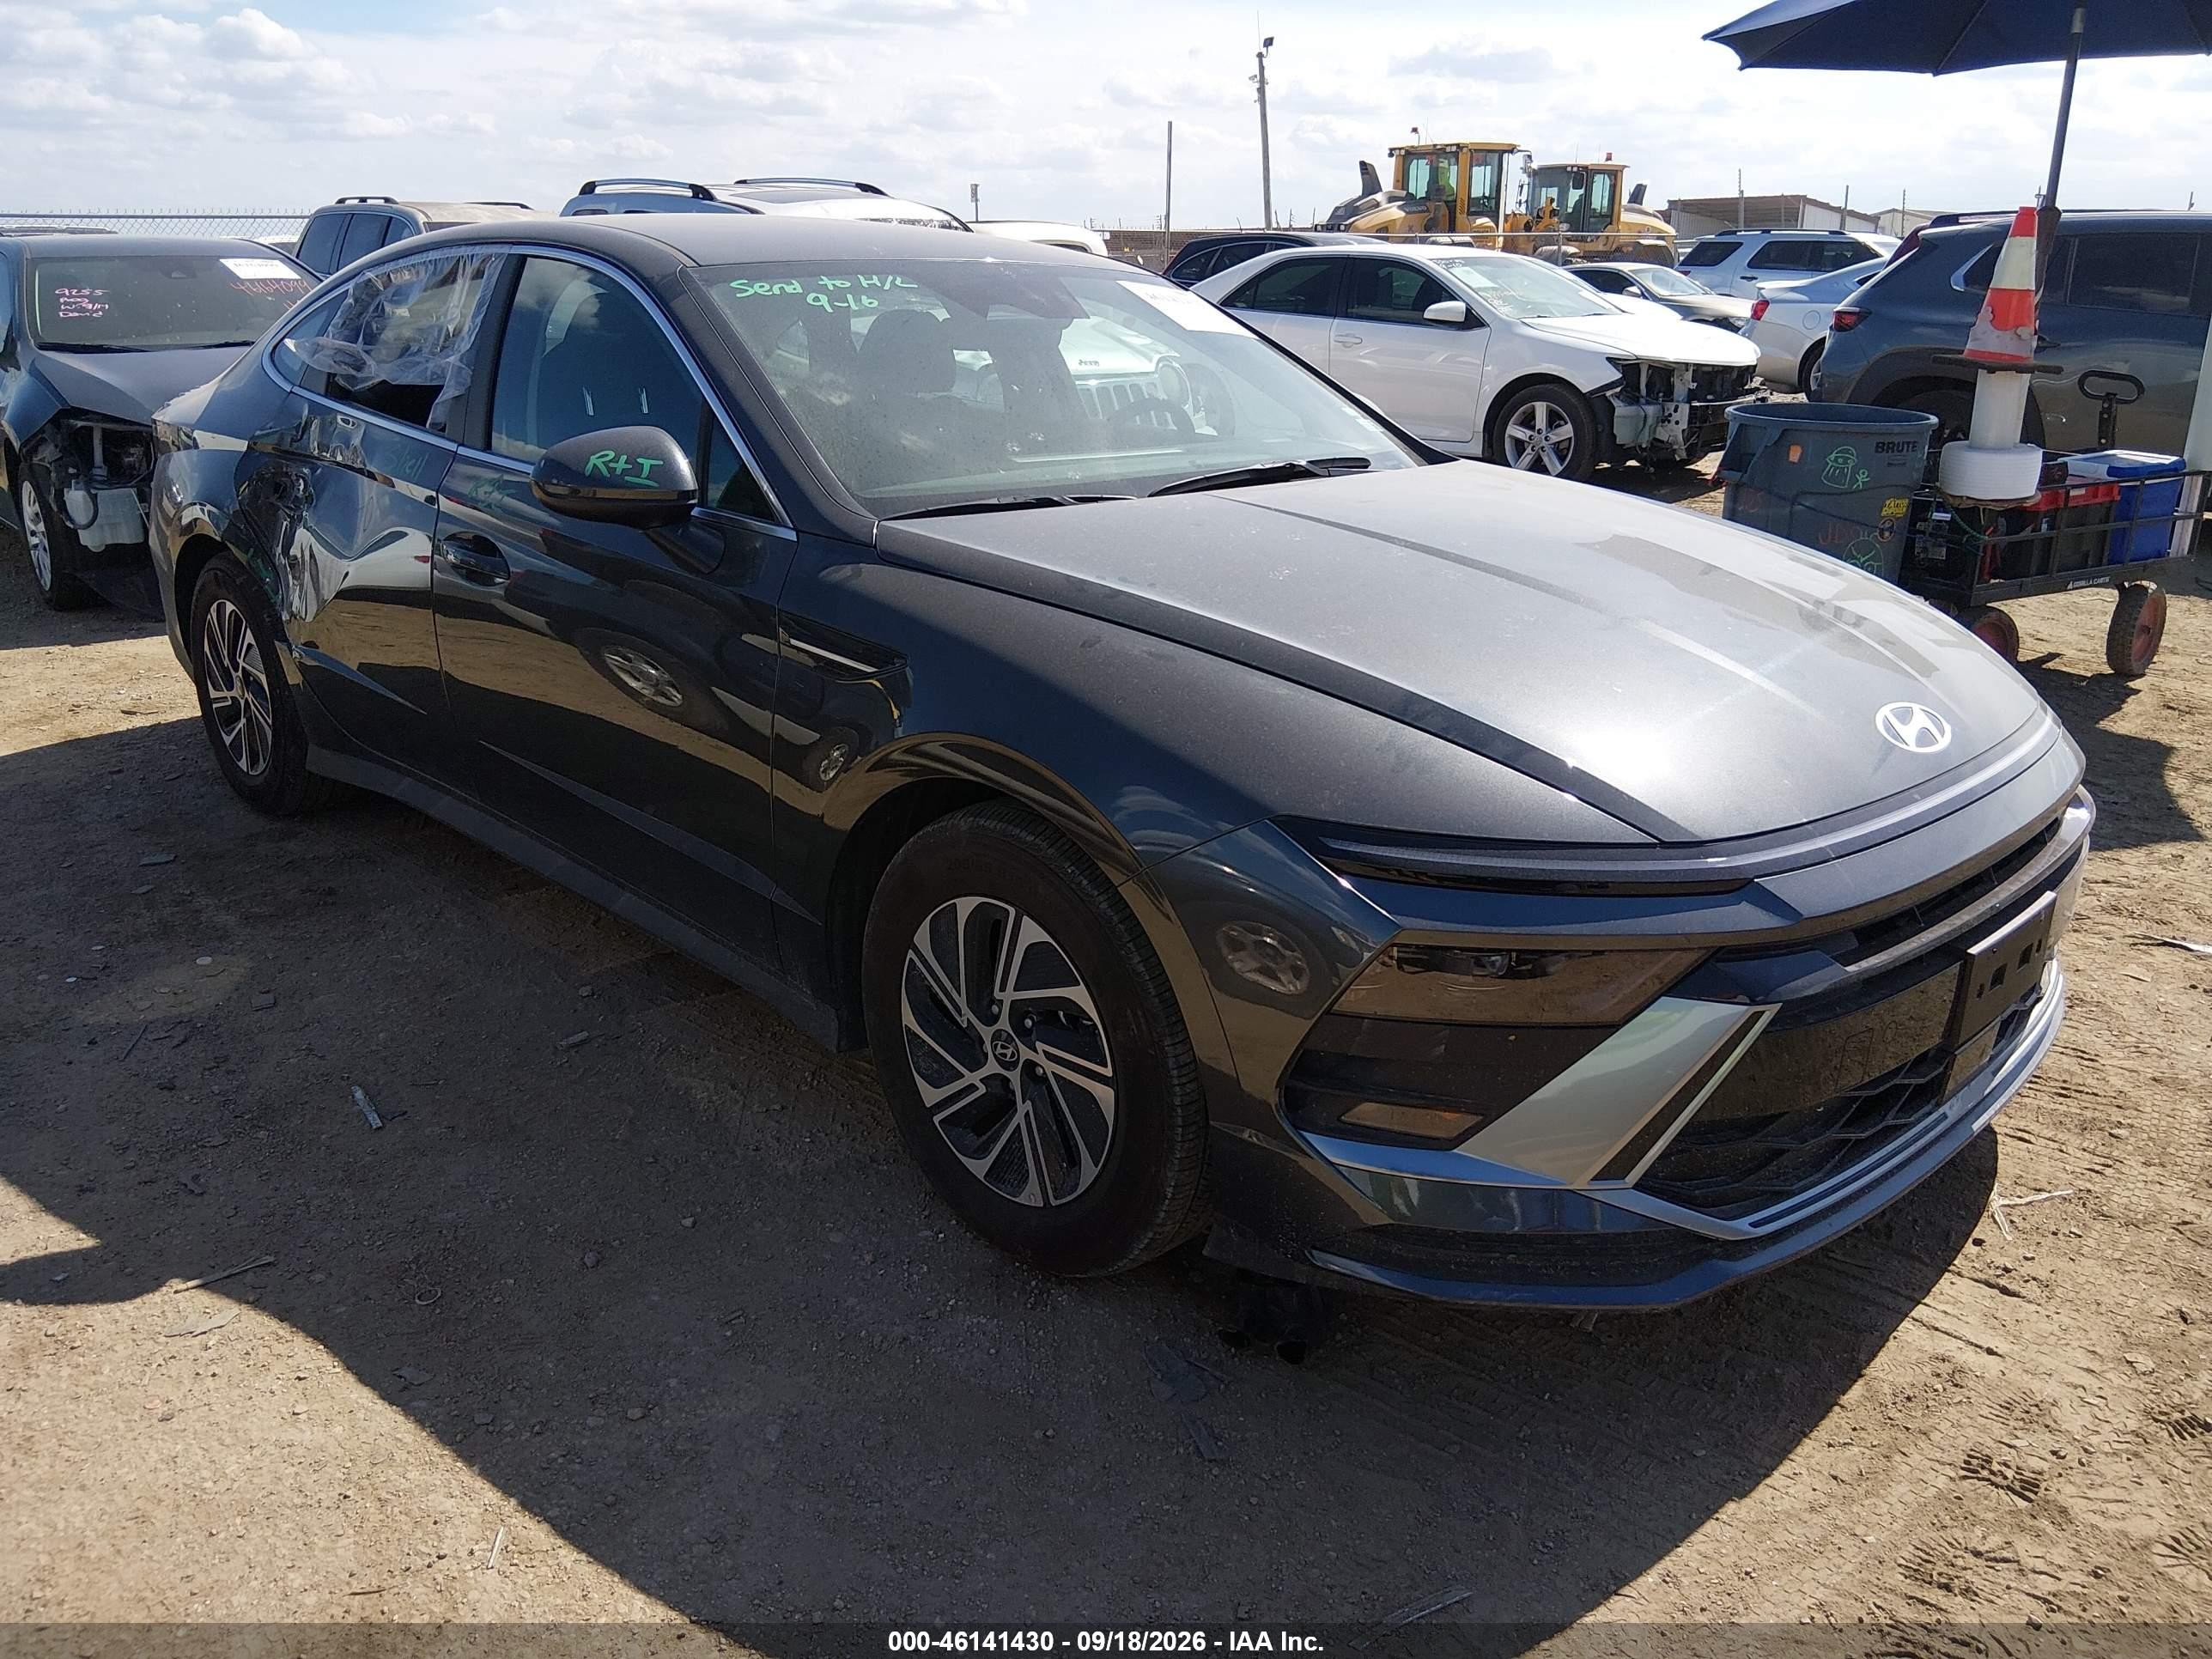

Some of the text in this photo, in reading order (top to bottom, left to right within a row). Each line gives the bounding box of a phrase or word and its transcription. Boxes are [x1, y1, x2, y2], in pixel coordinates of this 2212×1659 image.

[55, 288, 111, 296] 9255
[730, 279, 804, 298] Send
[817, 275, 852, 290] to
[1875, 441, 1917, 454] BRUTE
[585, 450, 665, 488] R+I
